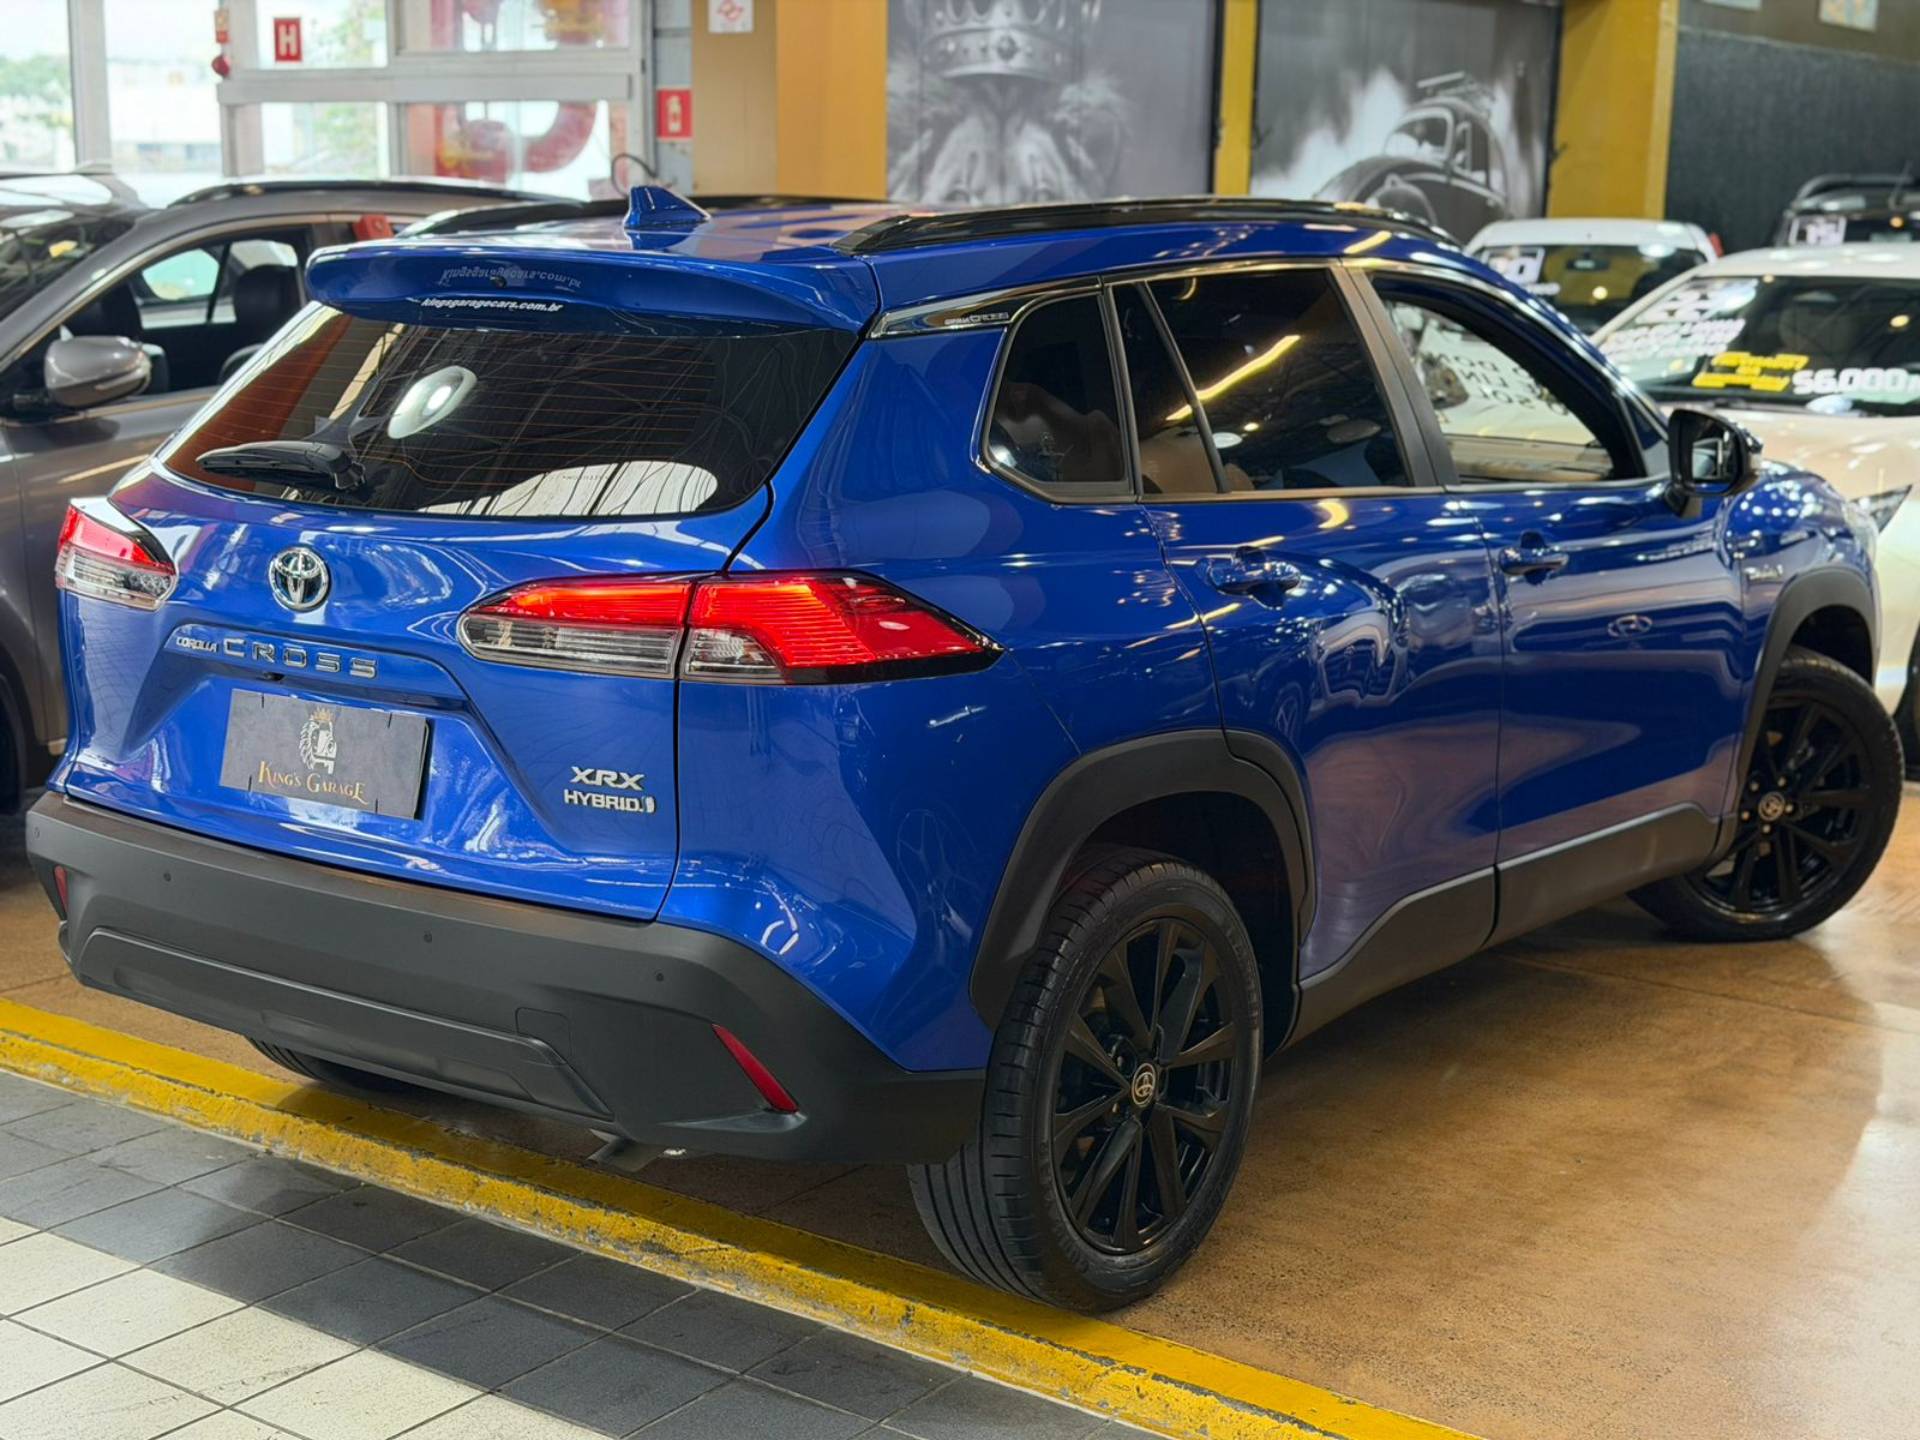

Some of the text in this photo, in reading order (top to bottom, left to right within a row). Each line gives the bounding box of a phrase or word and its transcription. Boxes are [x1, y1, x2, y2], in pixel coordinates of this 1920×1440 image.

[421, 297, 564, 312] kingsgaragecars.com.br
[176, 636, 378, 679] COROLLA CROSS
[569, 765, 646, 791] XRX
[563, 788, 641, 812] HYBRID
